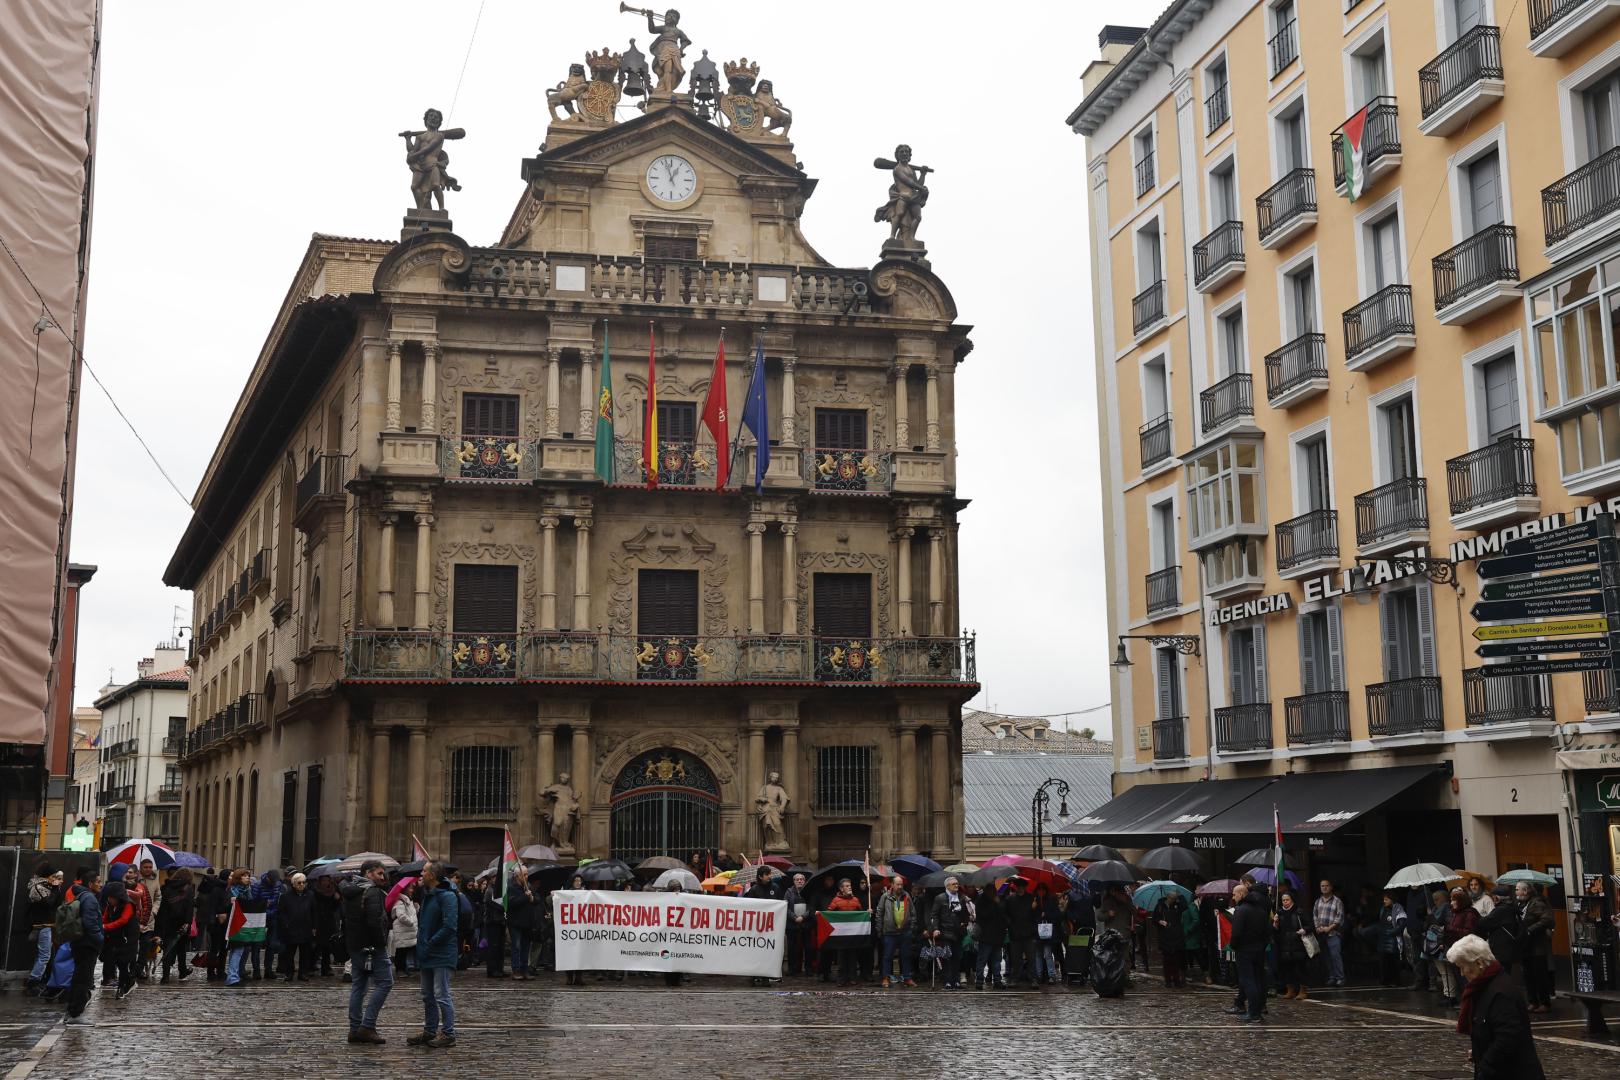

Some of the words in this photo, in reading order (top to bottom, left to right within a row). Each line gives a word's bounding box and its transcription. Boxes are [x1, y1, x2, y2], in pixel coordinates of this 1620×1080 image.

[1525, 600, 1554, 608] Pamplona
[1554, 597, 1590, 605] Monumental
[1209, 592, 1290, 627] AGENCIA
[1519, 626, 1543, 635] Santiago
[1511, 788, 1518, 802] 2
[1056, 837, 1066, 847] BAR
[1194, 837, 1208, 848] BAR
[1209, 837, 1226, 848] MOL
[560, 903, 661, 928] ELKARTASUNA
[666, 906, 686, 928] EZ
[690, 907, 710, 930] DA
[715, 908, 775, 933] DELITUA
[561, 929, 637, 943] SOLIDARIDAD
[639, 931, 667, 943] CON
[669, 932, 727, 947] PALESTINE
[729, 936, 776, 950] ACTION
[670, 951, 704, 960] ELKARTASUNA
